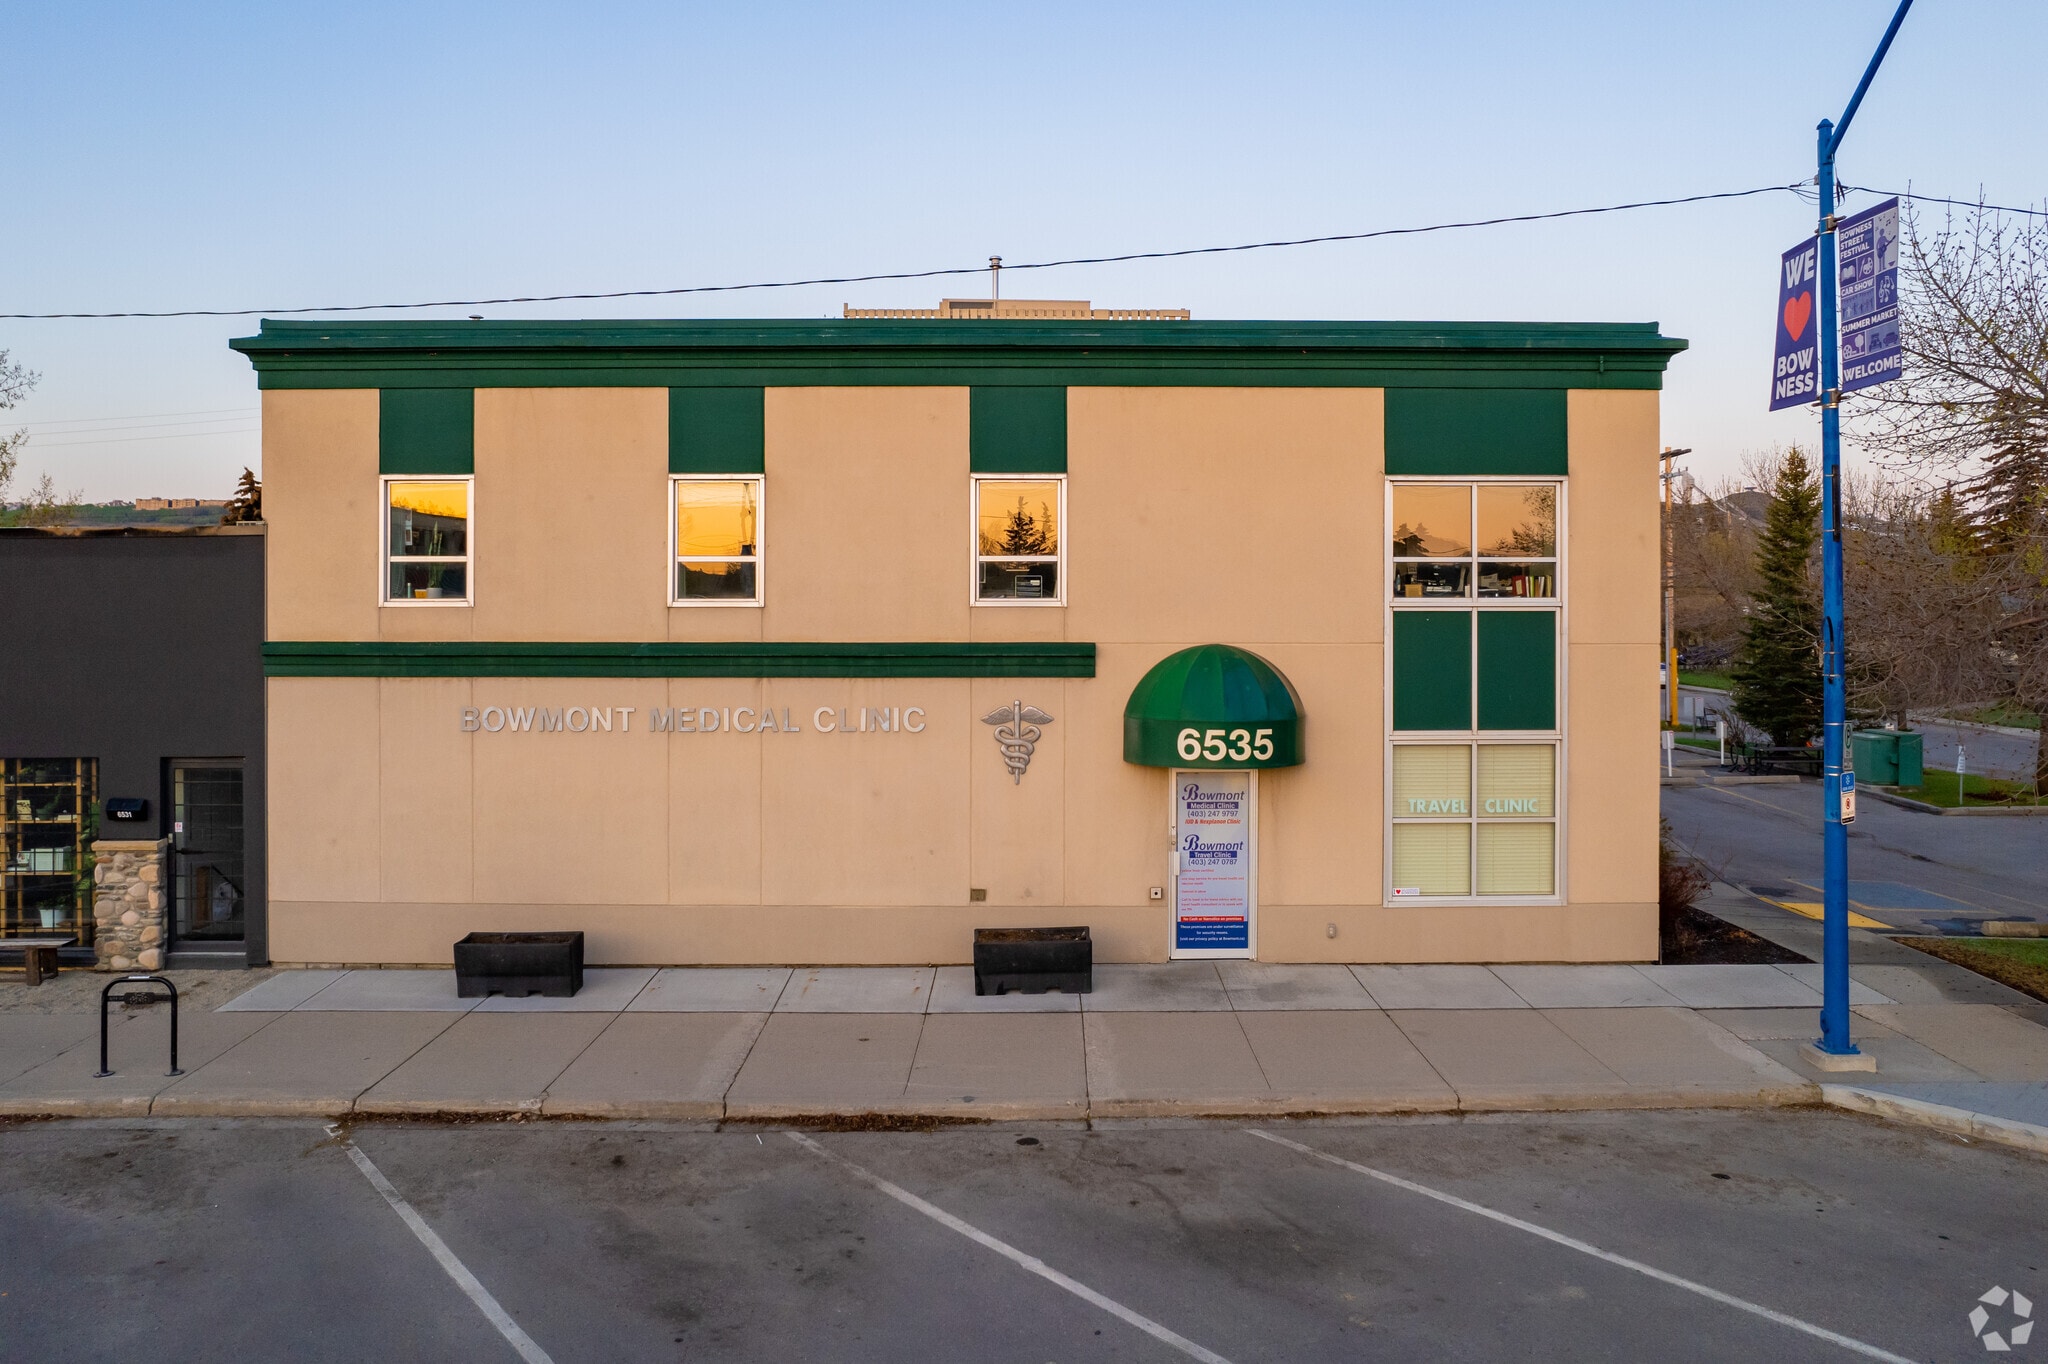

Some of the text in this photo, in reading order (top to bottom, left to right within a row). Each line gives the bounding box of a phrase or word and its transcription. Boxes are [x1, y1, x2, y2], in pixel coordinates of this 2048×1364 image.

[1840, 221, 1873, 241] BOWNESS
[1840, 233, 1865, 251] STREET
[1840, 242, 1870, 260] FESTIVAL
[1785, 247, 1815, 289] WE
[1841, 278, 1874, 297] CAR SHOW
[1841, 307, 1898, 334] SUMMER MARKET
[1776, 347, 1814, 378] BOW
[1843, 354, 1901, 382] WELCOME
[1775, 371, 1815, 400] NESS
[460, 706, 926, 732] BOWMONT MEDICAL CLINIC
[1177, 728, 1274, 761] 6535
[1182, 783, 1245, 801] Bowmont
[1187, 810, 1206, 818] (403)
[1408, 799, 1538, 813] TRAVEL CLINIC
[1183, 834, 1243, 851] Bowmont
